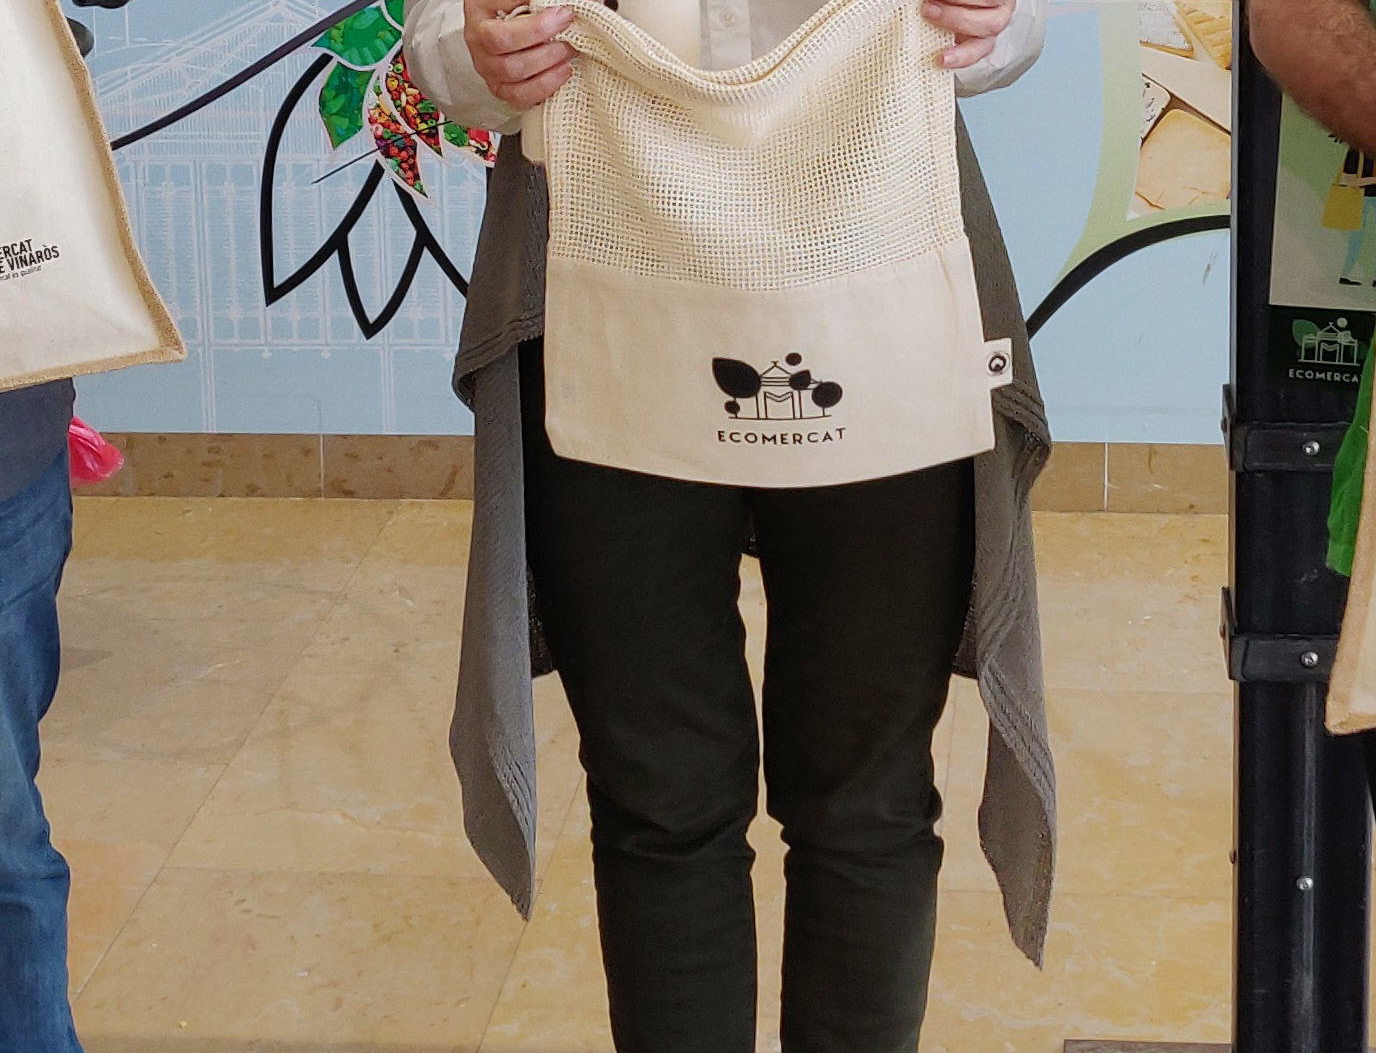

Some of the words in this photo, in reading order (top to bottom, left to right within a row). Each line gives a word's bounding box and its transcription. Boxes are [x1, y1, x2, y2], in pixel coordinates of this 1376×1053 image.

[7, 245, 60, 271] VINARÒS
[1288, 368, 1362, 383] ECOMERCA
[717, 427, 846, 446] ECOMERCAT
